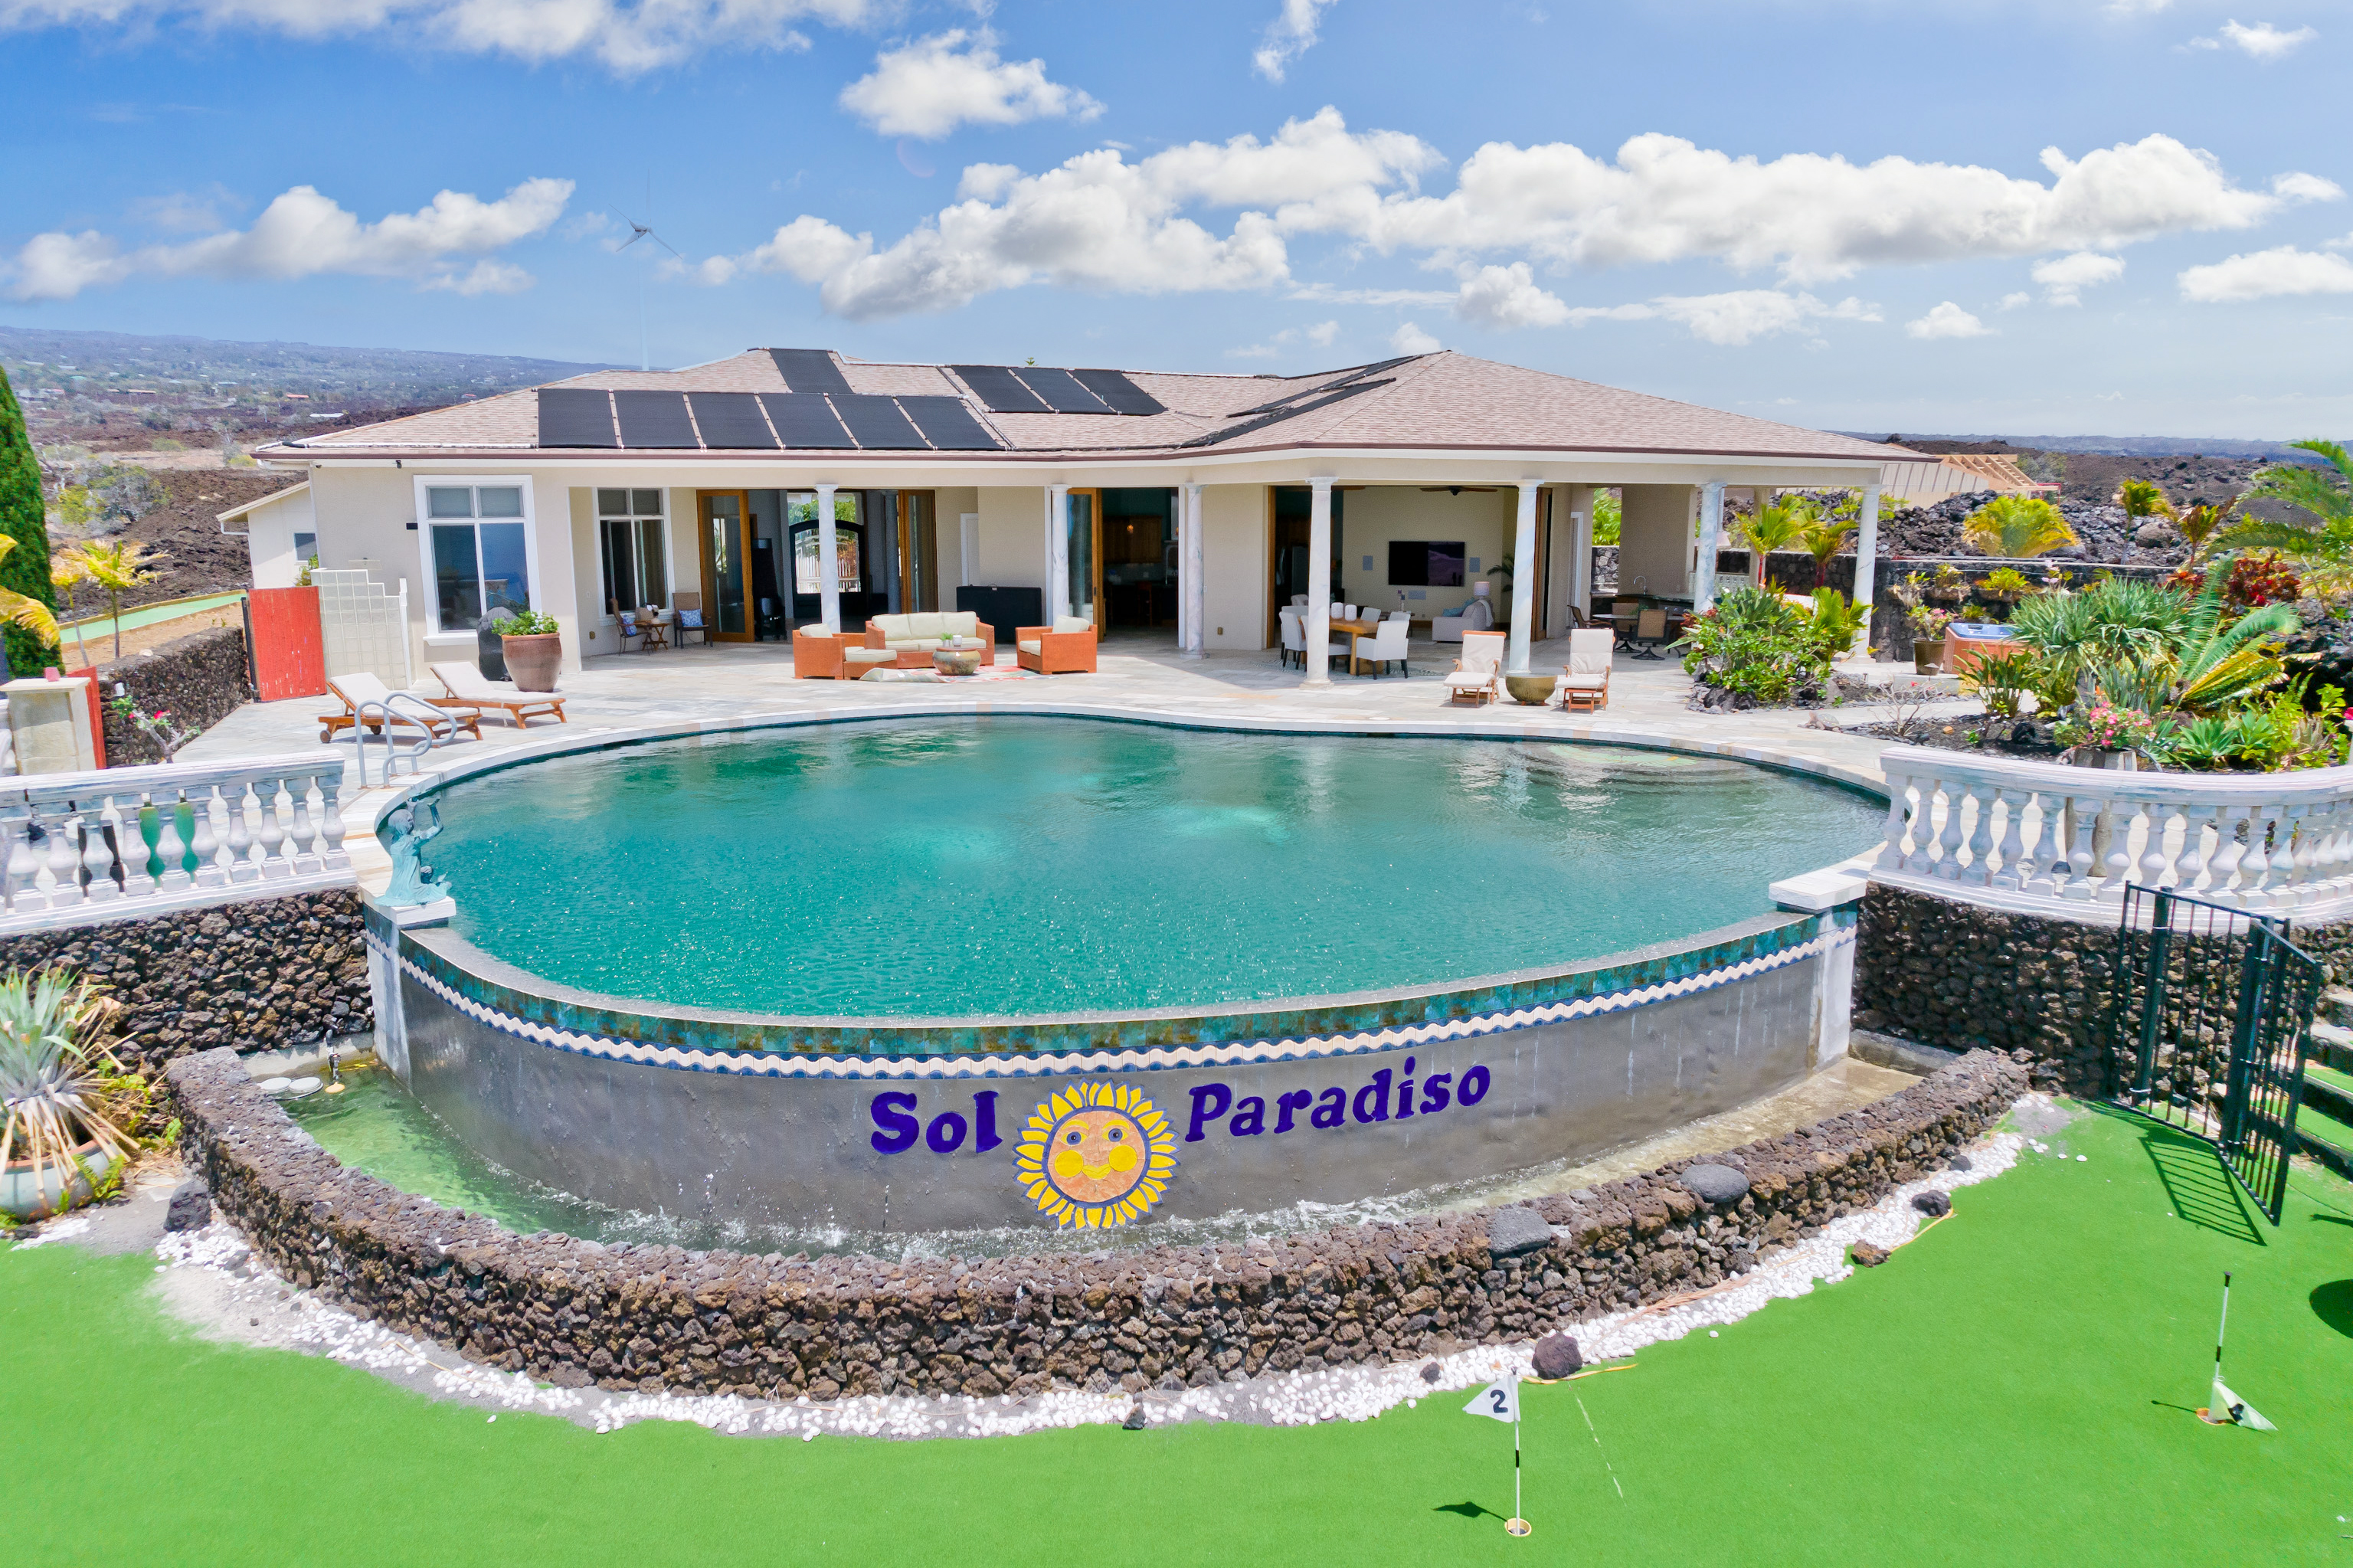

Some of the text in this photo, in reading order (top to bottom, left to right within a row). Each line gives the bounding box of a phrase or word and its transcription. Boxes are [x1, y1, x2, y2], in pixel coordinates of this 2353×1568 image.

[870, 1056, 1491, 1155] Sol Paradiso
[1490, 1390, 1508, 1413] 2
